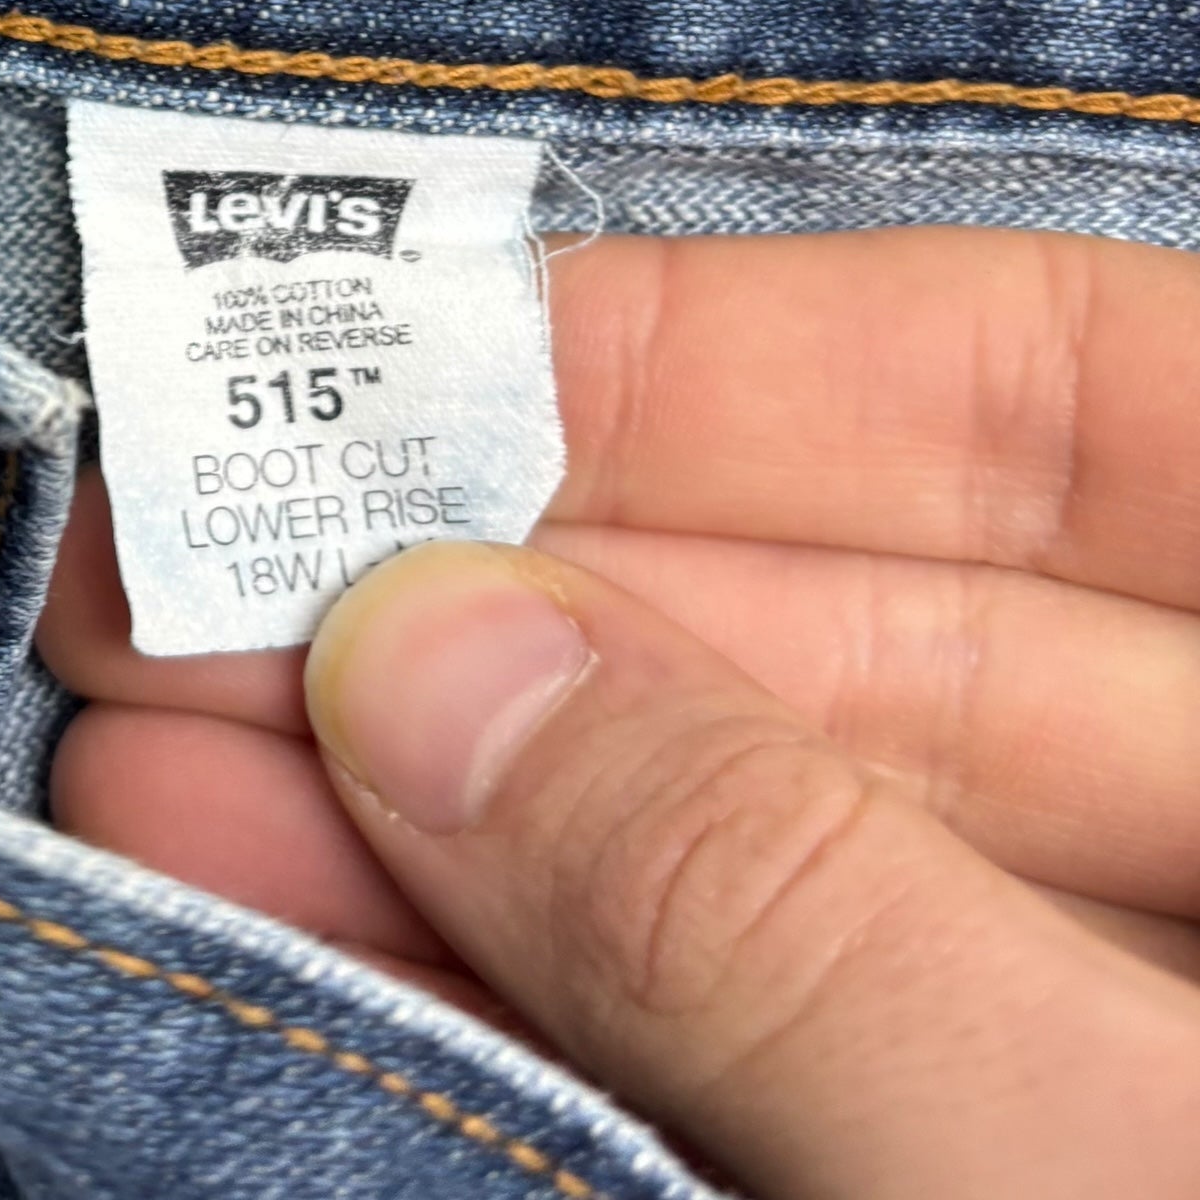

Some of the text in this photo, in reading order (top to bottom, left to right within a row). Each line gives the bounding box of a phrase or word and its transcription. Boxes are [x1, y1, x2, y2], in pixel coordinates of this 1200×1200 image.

[212, 277, 373, 309] 100% COTTON
[204, 302, 384, 335] MADE IN CHINA
[184, 324, 413, 362] CARE ON REVERSE
[192, 436, 438, 496] BOOT CUT
[181, 486, 471, 549] LOWER RISE
[226, 548, 322, 598] 18W
